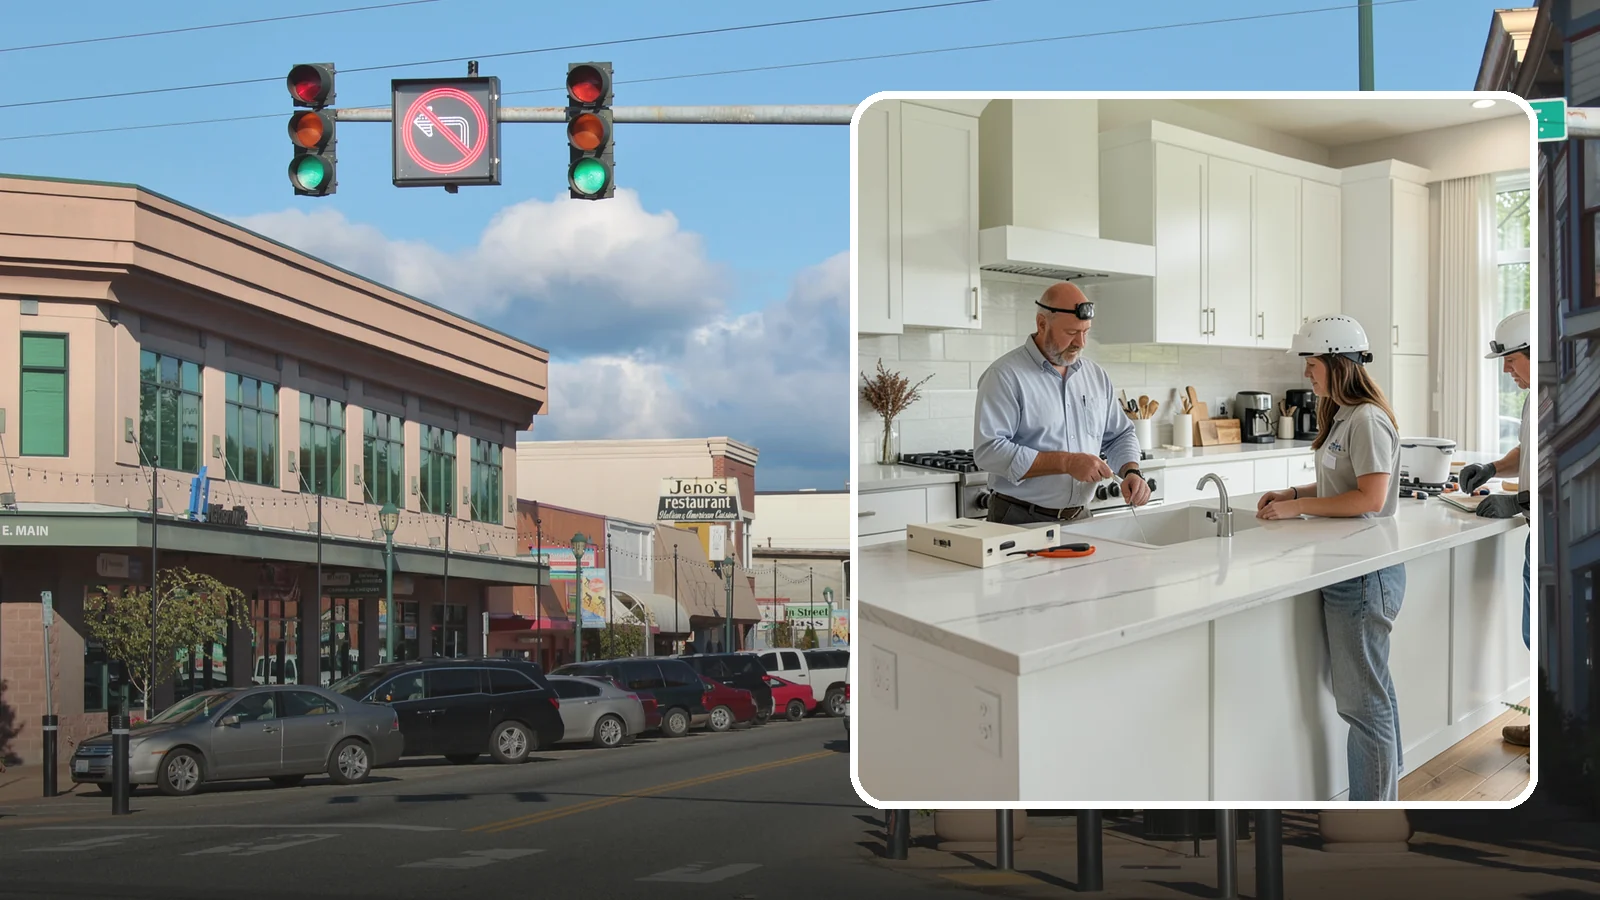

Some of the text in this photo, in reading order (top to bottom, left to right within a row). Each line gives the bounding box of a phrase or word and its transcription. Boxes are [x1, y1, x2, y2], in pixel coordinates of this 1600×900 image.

[669, 480, 728, 495] Jeno's
[665, 496, 731, 509] restaurant
[658, 510, 681, 519] Italian
[686, 510, 715, 519] American
[715, 510, 738, 519] Cuisine
[2, 525, 49, 536] E. MAIN
[797, 607, 829, 617] Street
